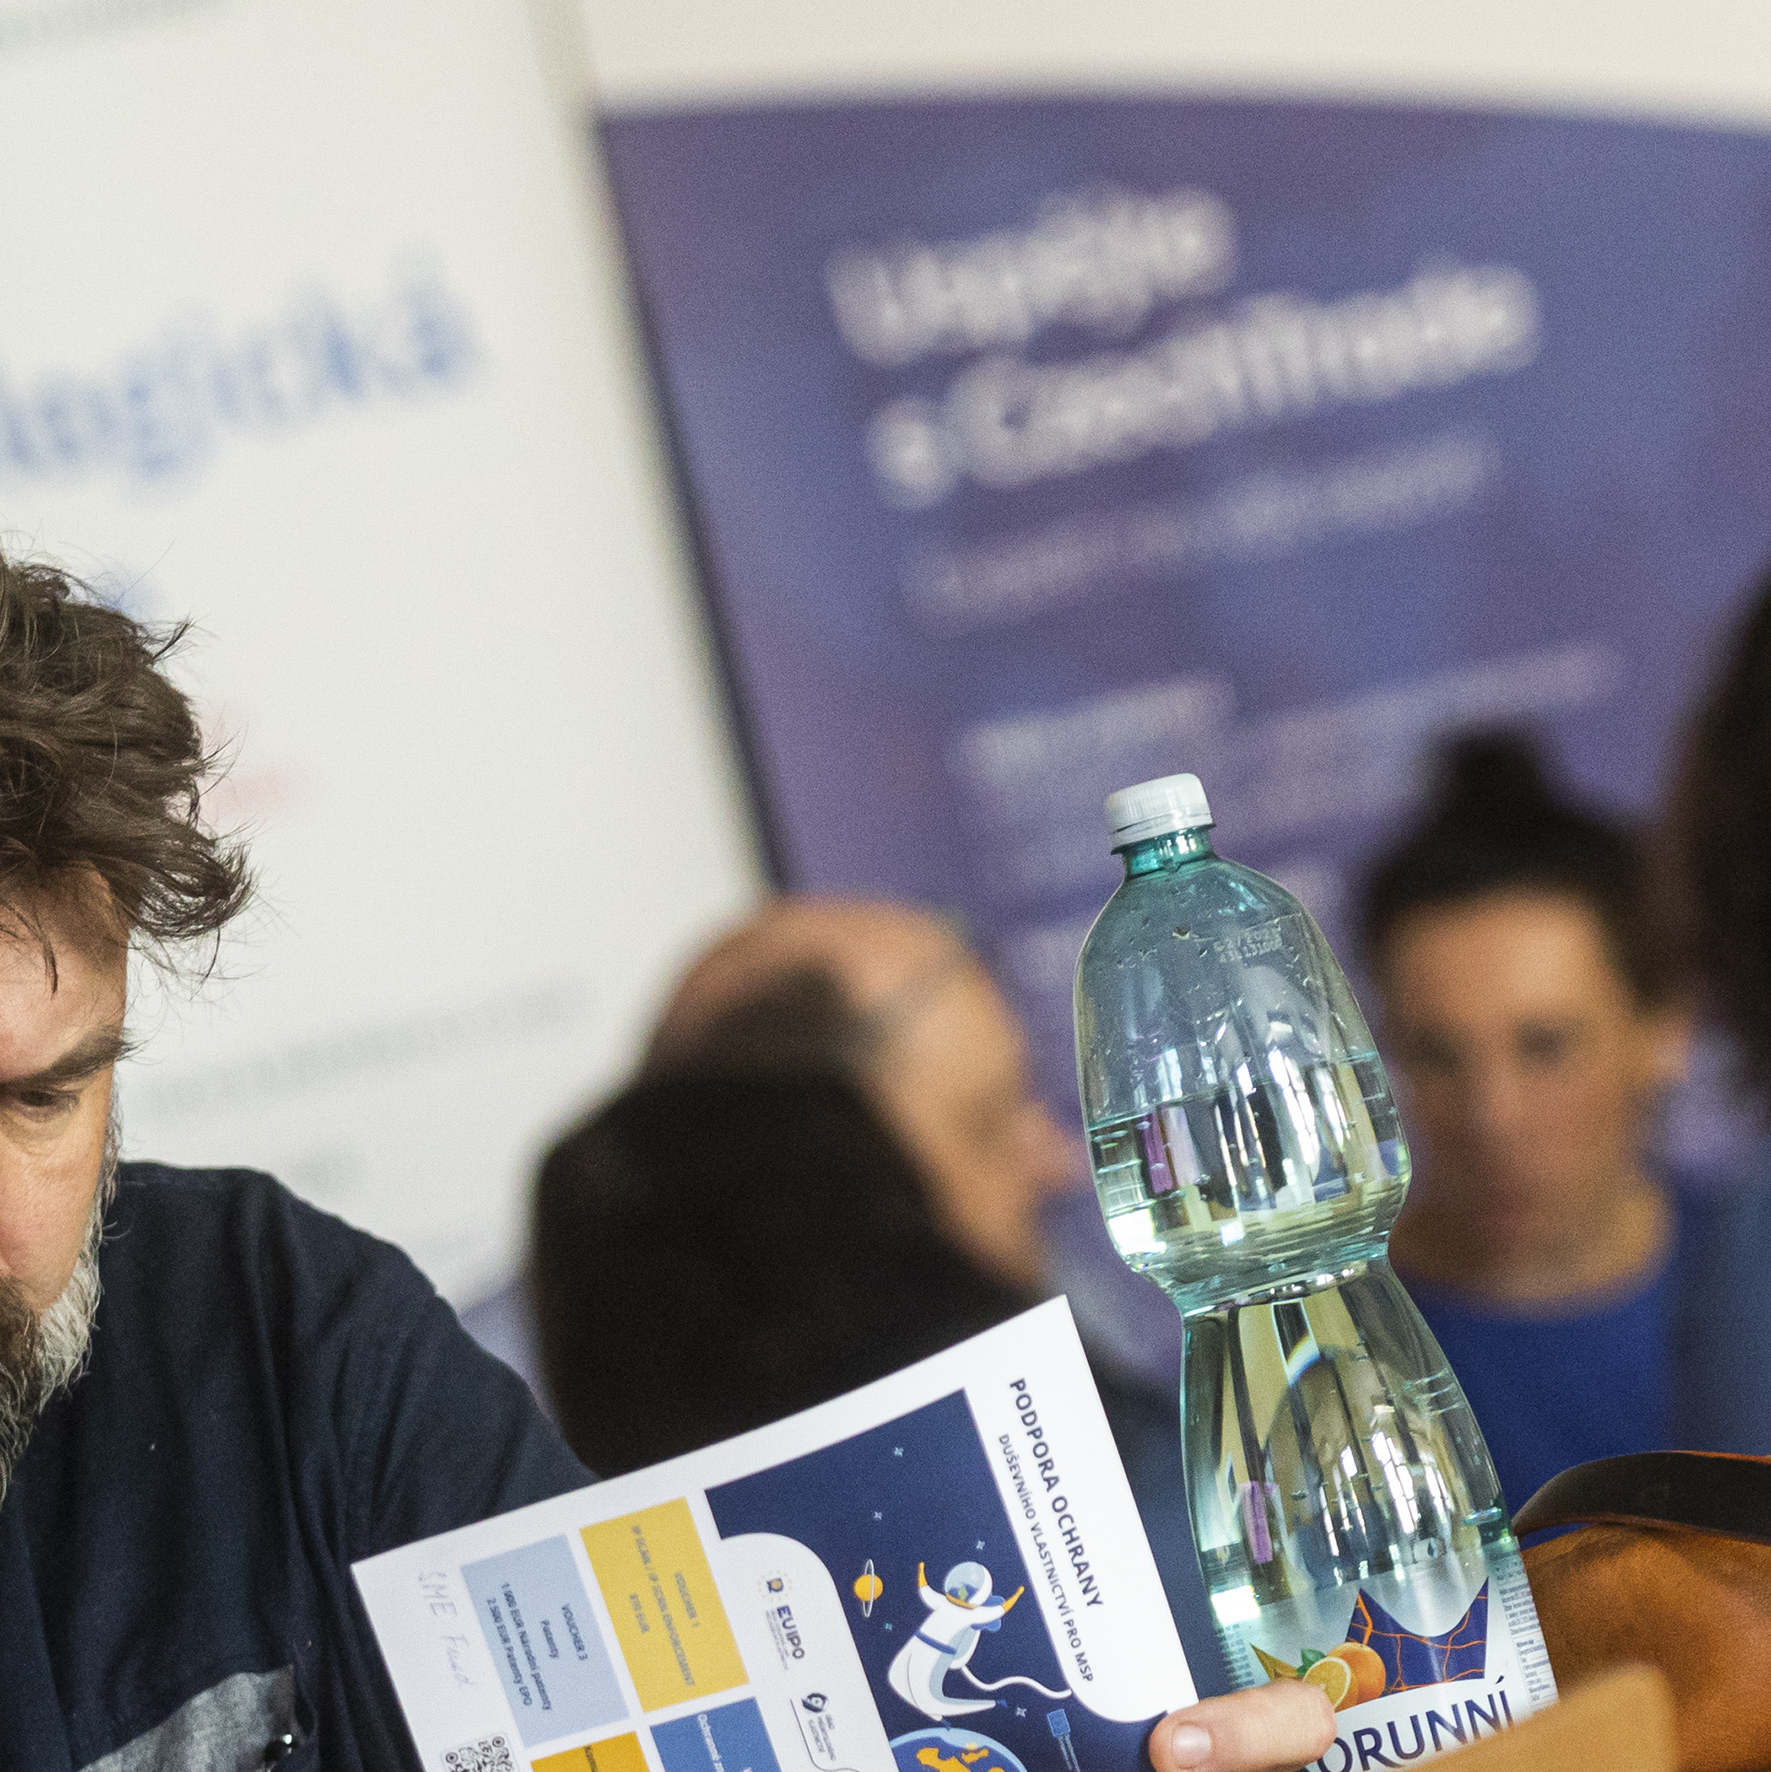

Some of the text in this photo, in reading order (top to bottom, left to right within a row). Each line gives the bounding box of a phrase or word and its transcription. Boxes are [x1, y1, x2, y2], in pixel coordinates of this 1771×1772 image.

[1009, 1377, 1103, 1607] PODPORA OCHRANY
[998, 1433, 1094, 1682] DUŠEVNÍHO VLASTNICTVÍ PRO MSP
[486, 1597, 496, 1605] 2
[496, 1624, 510, 1644] EUR
[504, 1645, 524, 1685] Patenty
[518, 1685, 533, 1706] EPO
[509, 1608, 524, 1629] EUR
[530, 1671, 553, 1711] patenty
[540, 1619, 560, 1660] Patenty
[560, 1603, 588, 1661] VOUCHER 3
[776, 1604, 805, 1660] EUIPO
[696, 1712, 722, 1761] Ochranné
